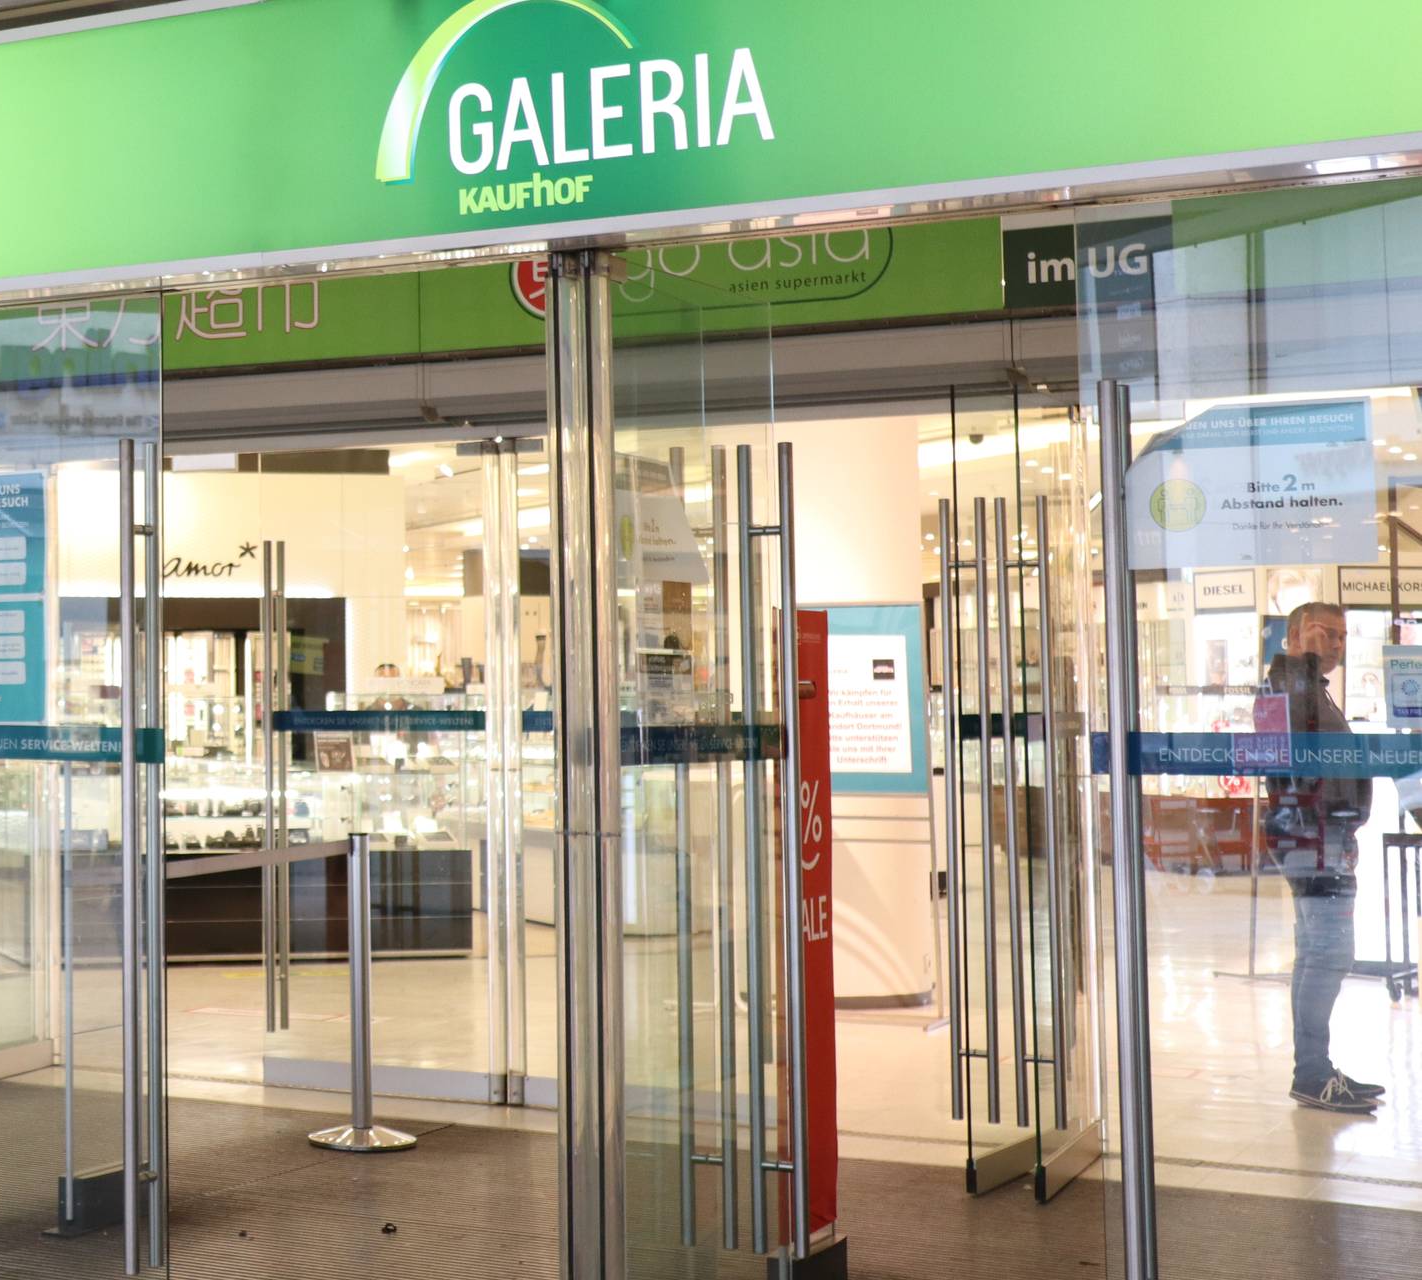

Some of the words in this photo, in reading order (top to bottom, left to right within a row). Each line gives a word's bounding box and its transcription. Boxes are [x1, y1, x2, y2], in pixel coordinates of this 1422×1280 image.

[448, 47, 775, 175] GALERIA
[1027, 251, 1075, 284] im
[1087, 243, 1149, 279] UG
[729, 278, 769, 294] asien
[775, 270, 867, 292] supermarkt
[1211, 419, 1234, 429] UNS
[1238, 416, 1267, 428] ÜBER
[1270, 415, 1305, 426] IHREN
[1309, 413, 1354, 424] BESUCH
[1247, 481, 1280, 493] Bitte
[1283, 474, 1297, 492] 2
[1301, 481, 1315, 491] m
[1221, 495, 1285, 510] Abstand
[1290, 495, 1343, 508] halten.
[162, 557, 241, 578] amor
[1202, 584, 1246, 596] DIESEL
[1342, 581, 1393, 592] MICHAEL
[1159, 747, 1258, 762] ENTDECKEN
[1264, 748, 1289, 763] SIE
[1294, 748, 1362, 764] UNSERE
[801, 896, 829, 942] ALE
